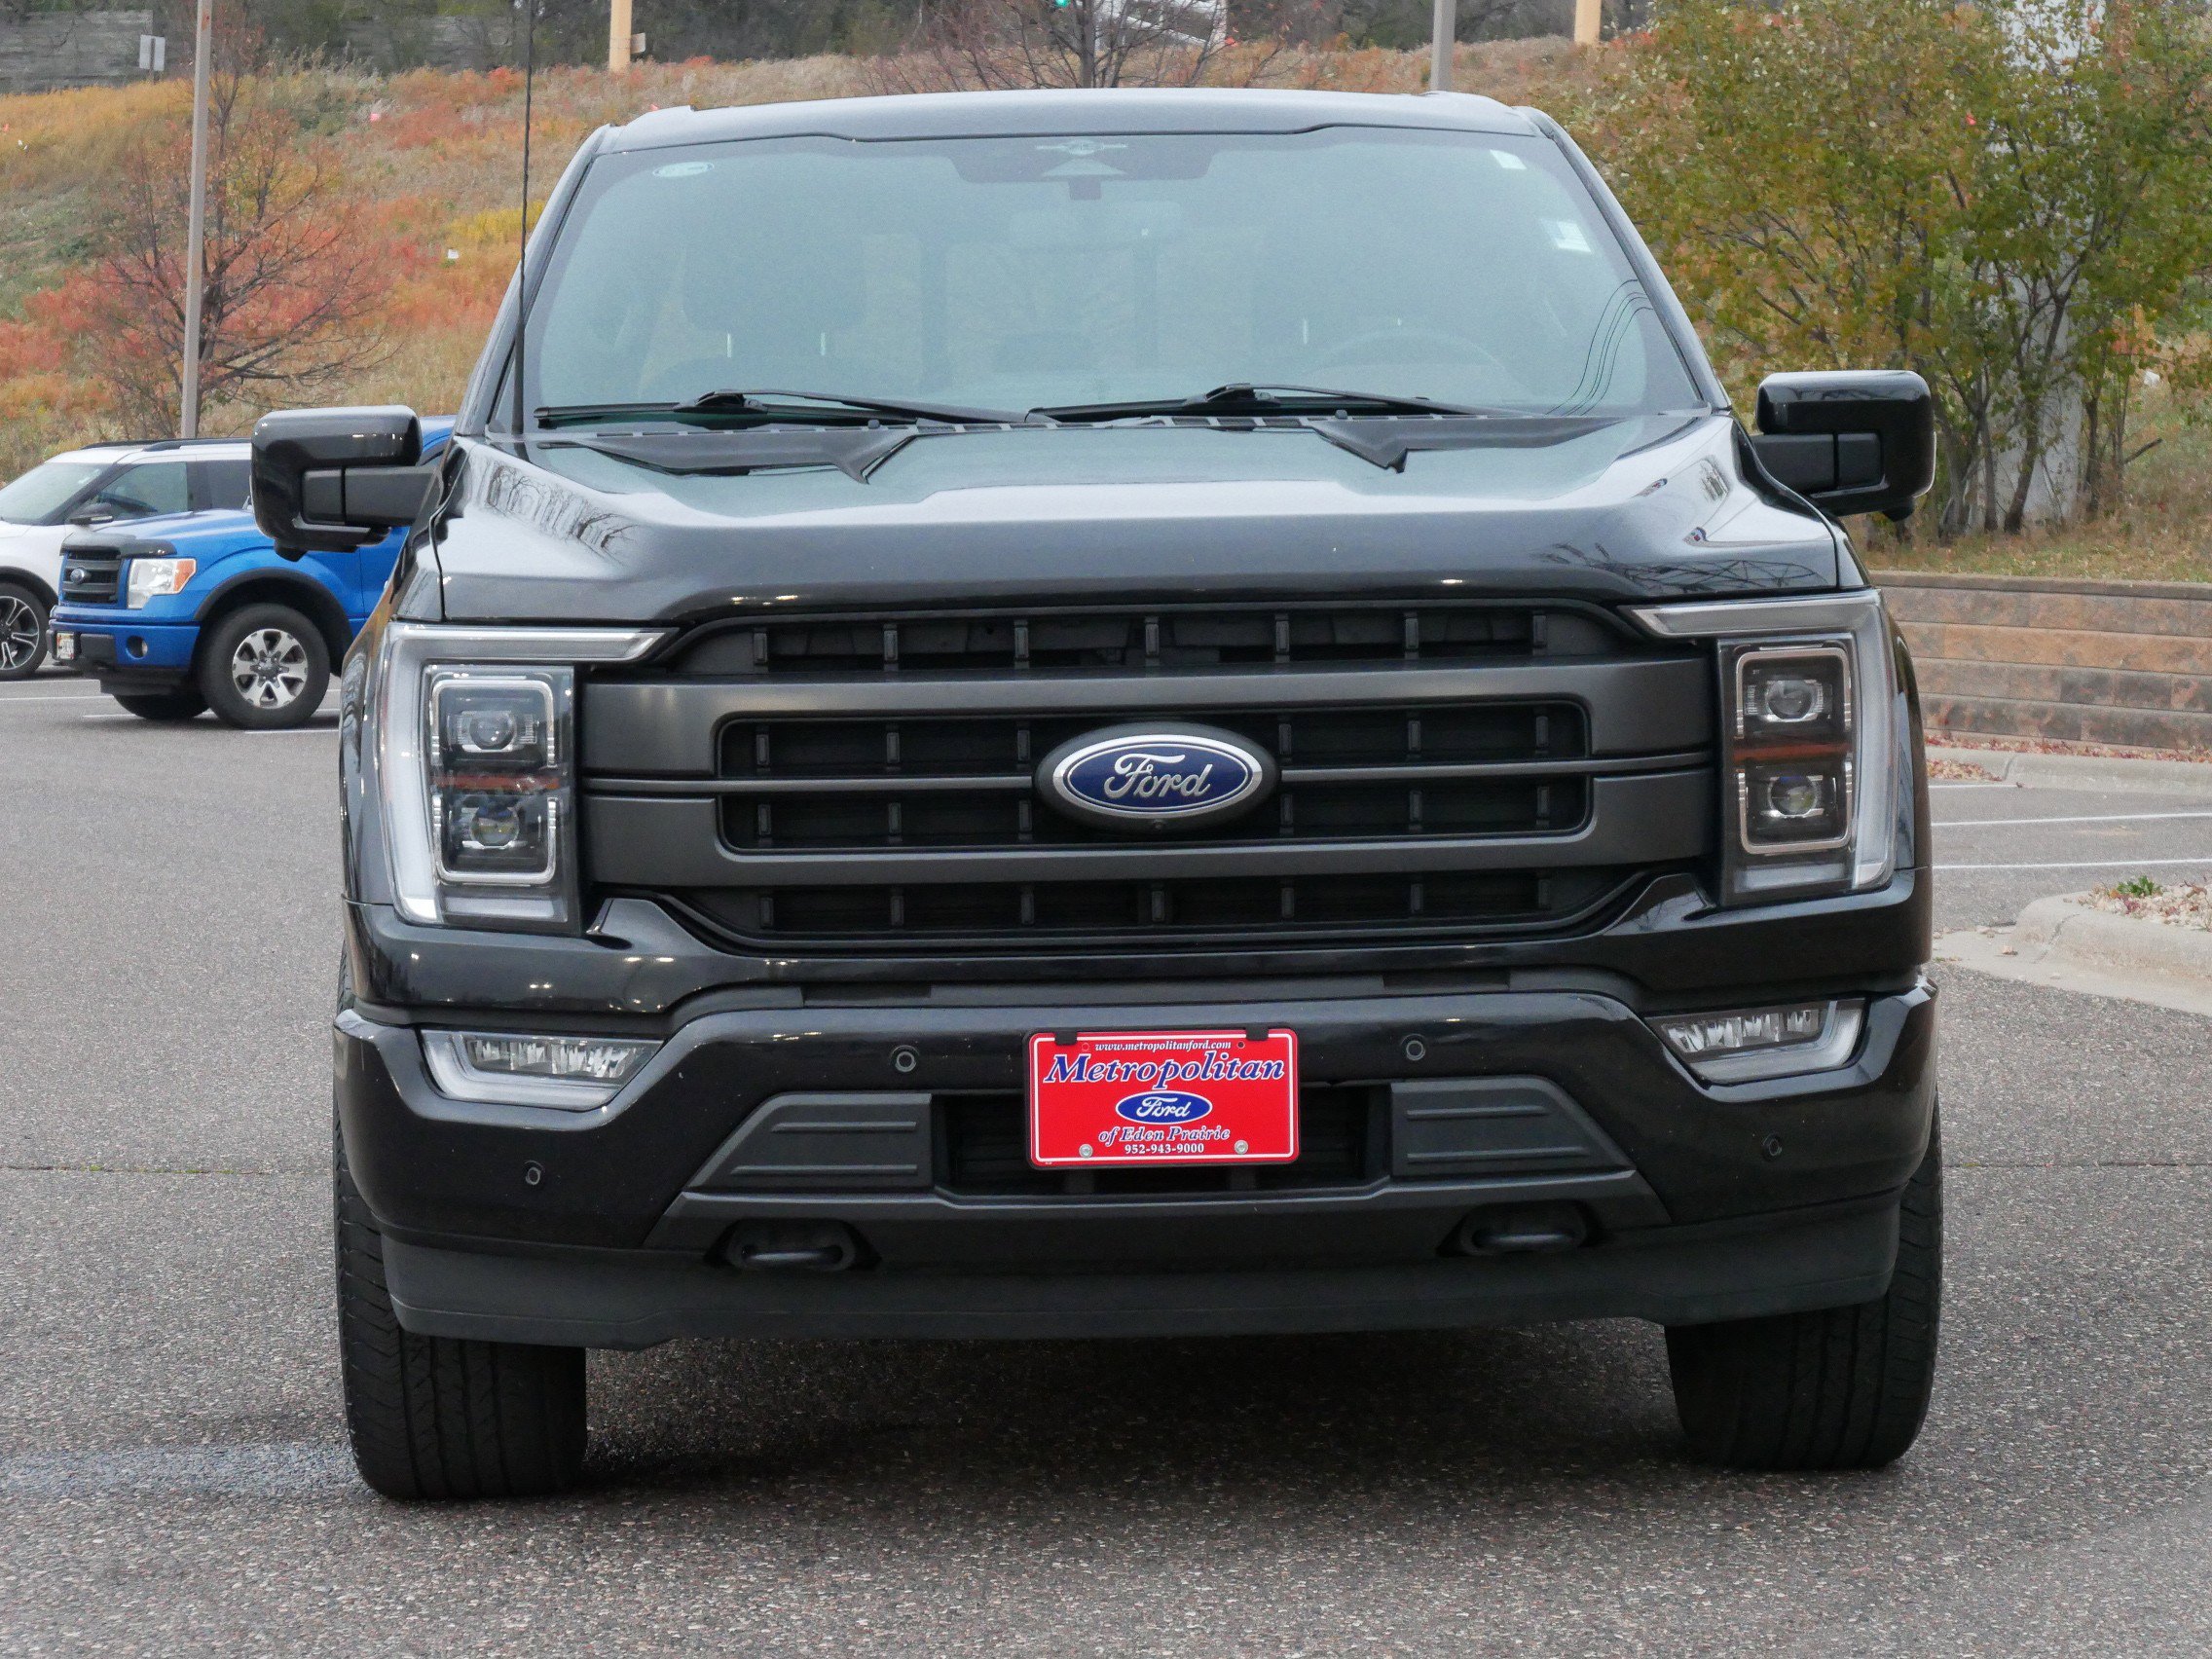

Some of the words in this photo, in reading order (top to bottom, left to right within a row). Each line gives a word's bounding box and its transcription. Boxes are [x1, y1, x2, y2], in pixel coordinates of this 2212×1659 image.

[1103, 753, 1213, 797] Ford
[1094, 1041, 1232, 1053] www.metropolitanford.com
[1043, 1051, 1285, 1089] Metropolitan
[1135, 1096, 1191, 1118] Ford
[1098, 1126, 1119, 1147] of
[1120, 1126, 1164, 1142] Eden
[1166, 1124, 1231, 1141] Prairie
[1124, 1142, 1204, 1154] 952-943-9000
